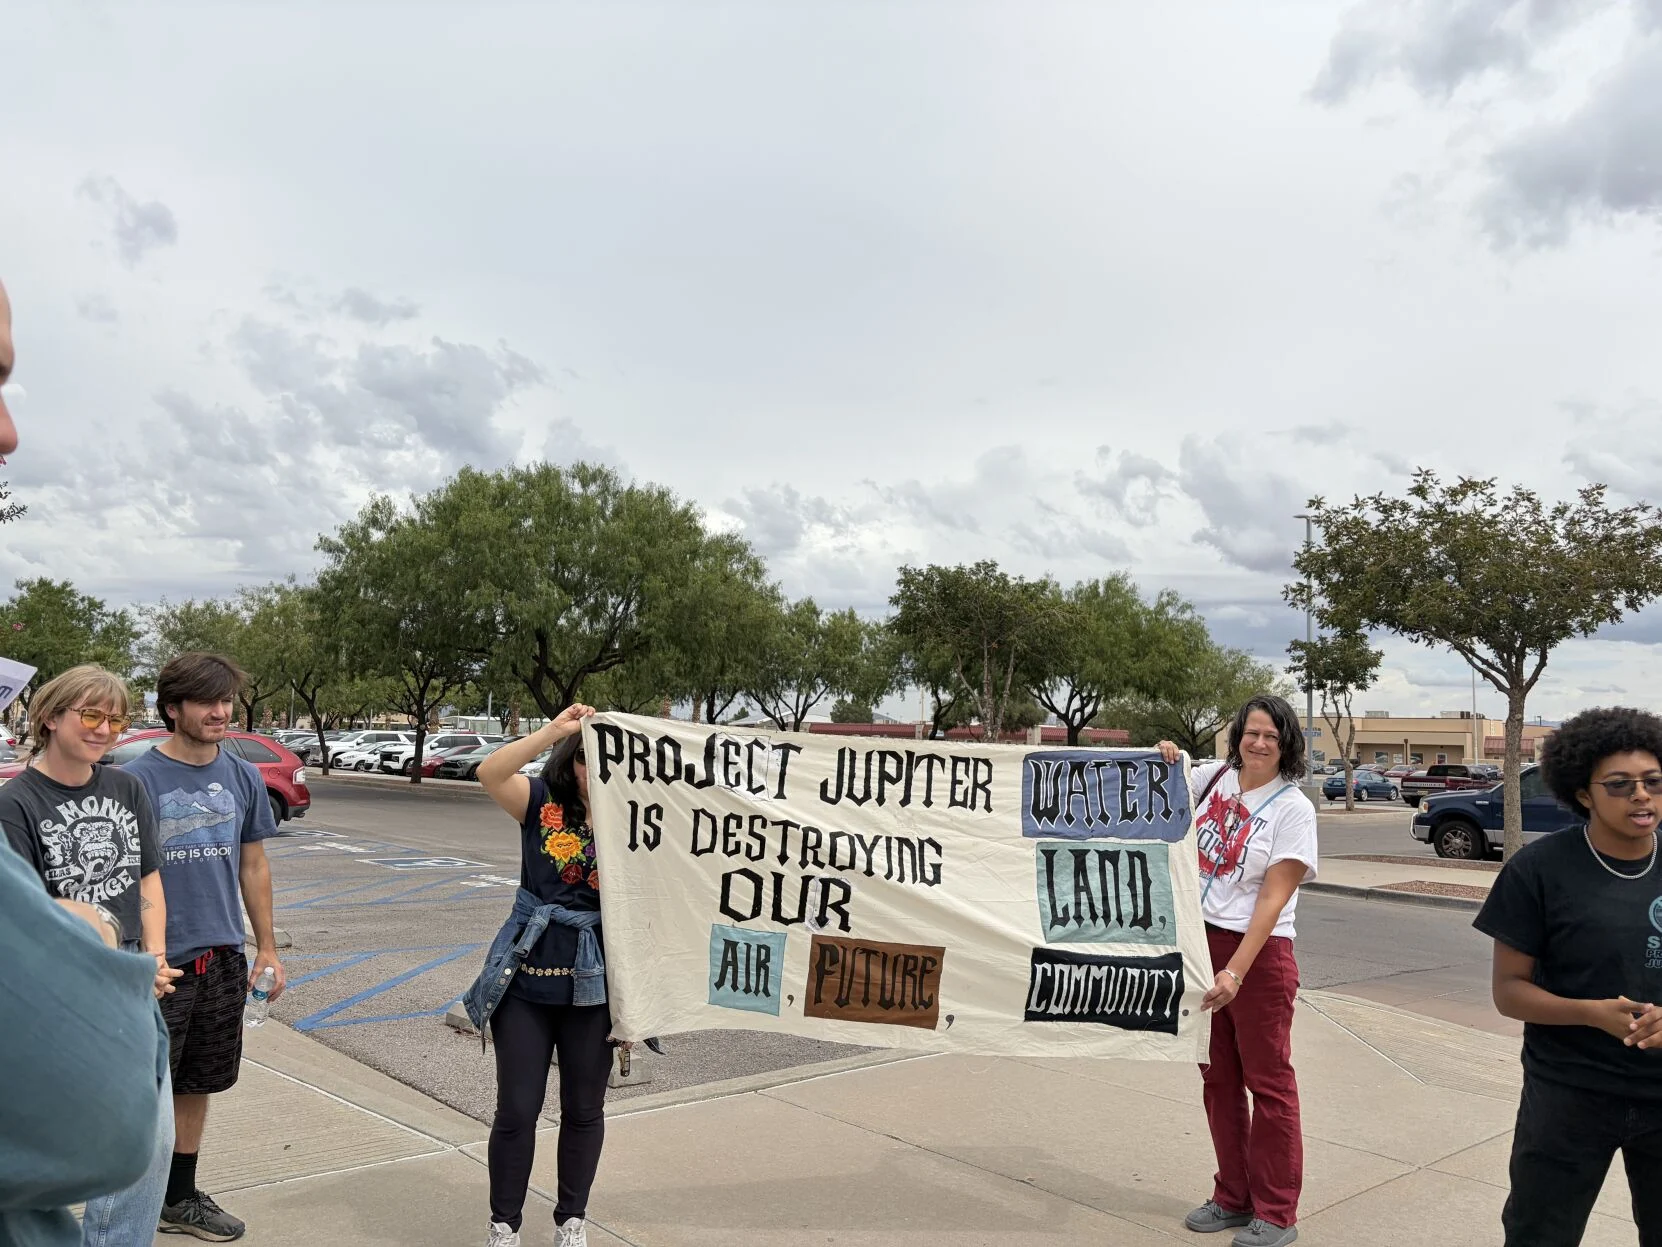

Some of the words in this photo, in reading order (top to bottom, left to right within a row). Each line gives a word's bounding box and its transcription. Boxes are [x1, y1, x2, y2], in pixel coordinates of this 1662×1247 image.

[591, 722, 803, 800] PROJECT
[819, 747, 993, 813] JUPITER
[1028, 759, 1186, 830] WATER,
[627, 800, 664, 851] IS
[690, 808, 943, 887] DESTROYING
[719, 867, 852, 932] OUR
[1041, 849, 1167, 931] LAND,
[813, 942, 955, 1030] FUTURE,
[1027, 962, 1190, 1018] COMMUNITY.
